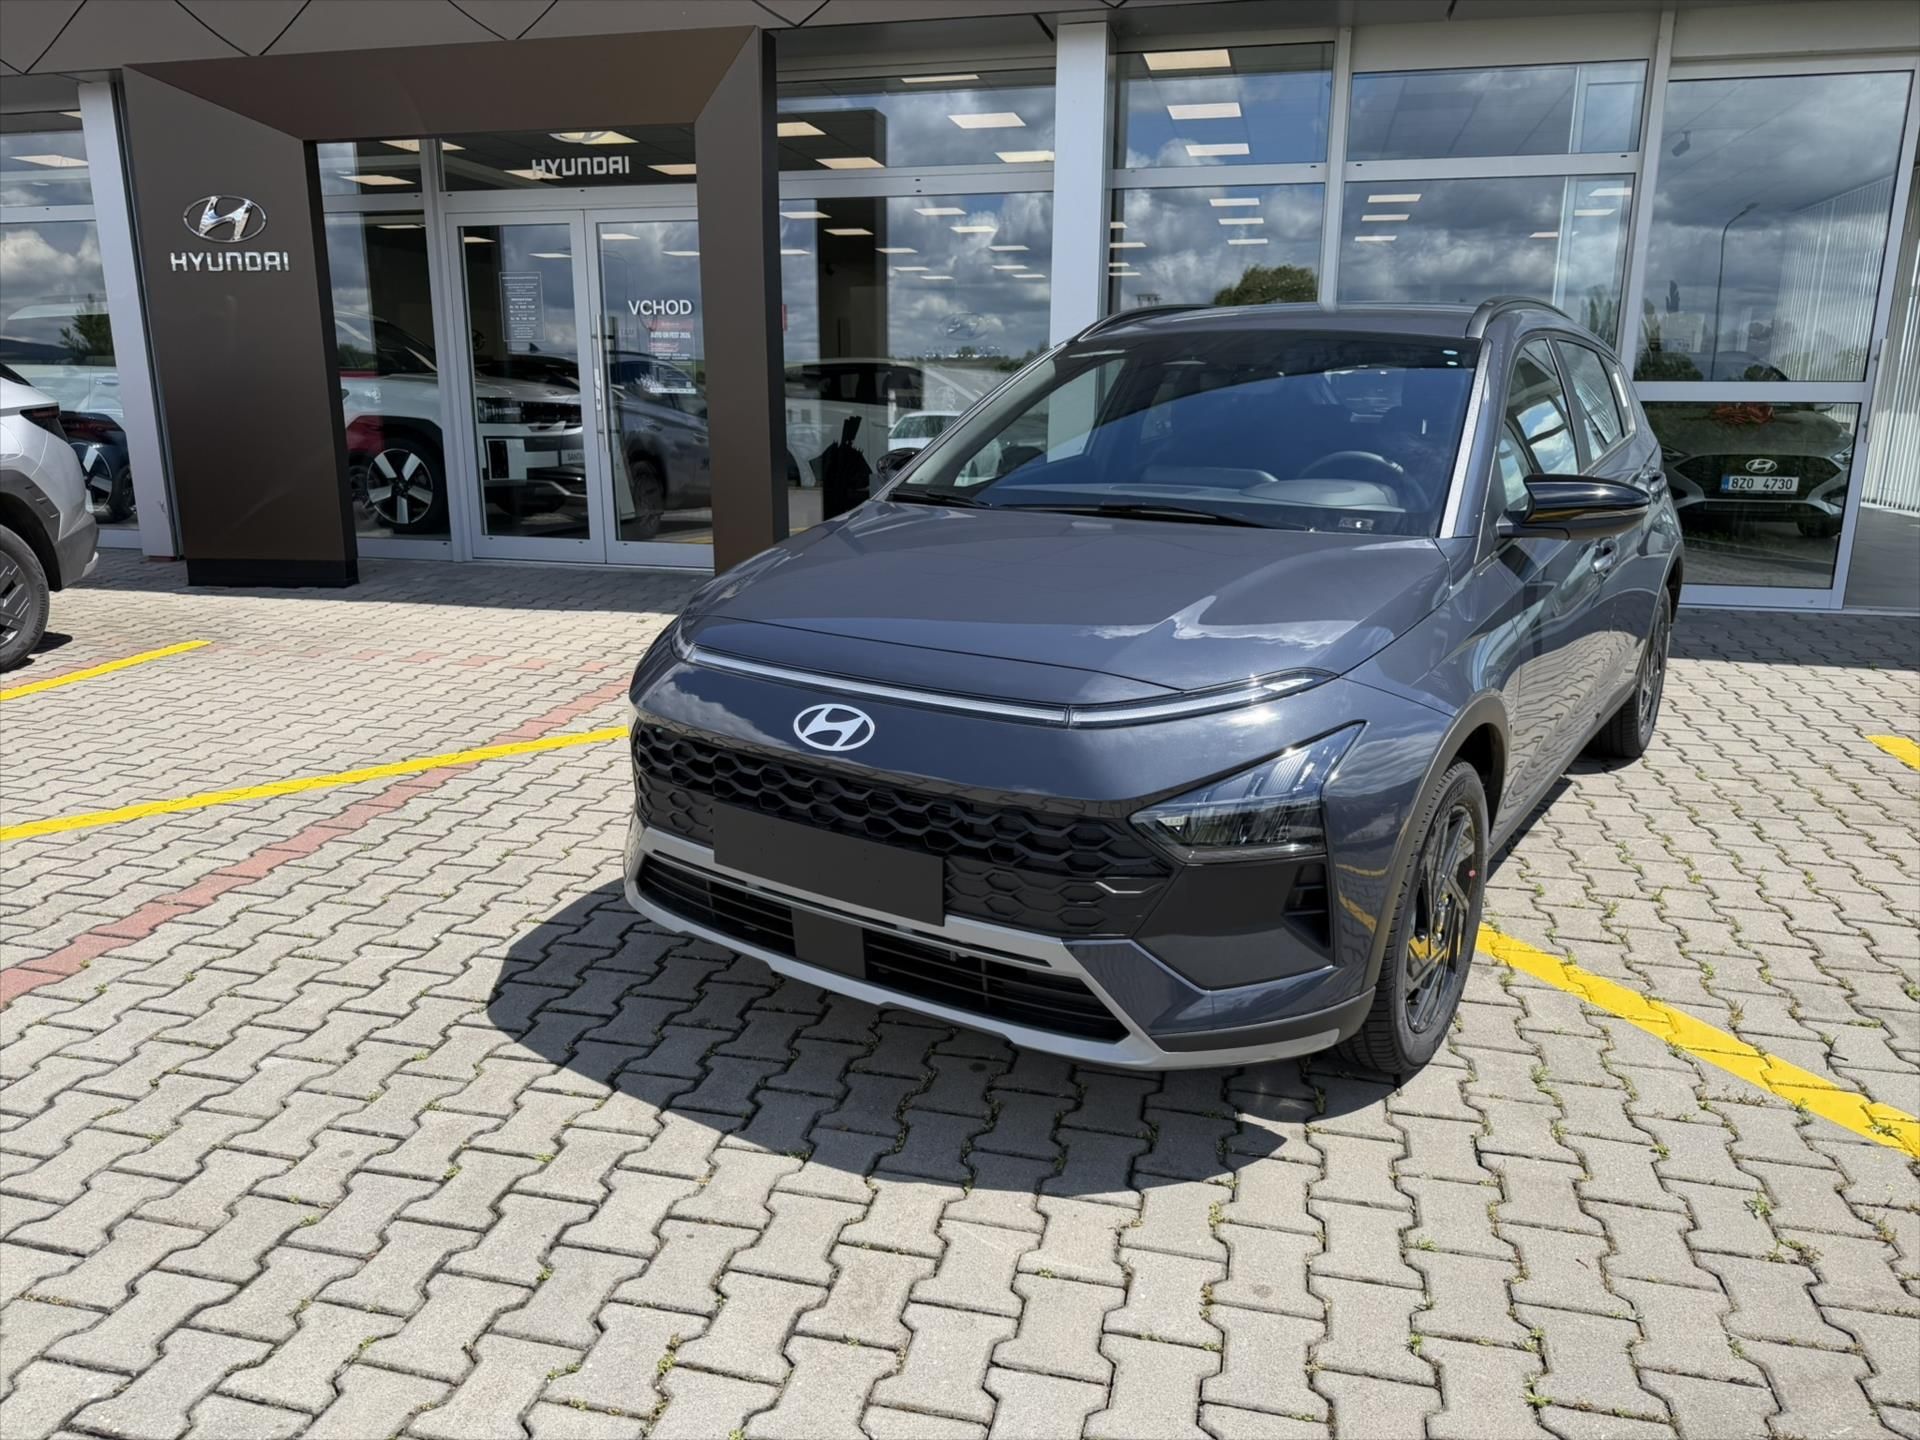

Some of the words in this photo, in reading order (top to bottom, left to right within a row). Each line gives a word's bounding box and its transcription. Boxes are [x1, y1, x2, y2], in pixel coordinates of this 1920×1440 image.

[532, 156, 630, 177] HYUNDAI
[170, 251, 290, 272] HYUNDAI
[628, 299, 692, 315] VCHOD
[1763, 478, 1793, 490] 4730
